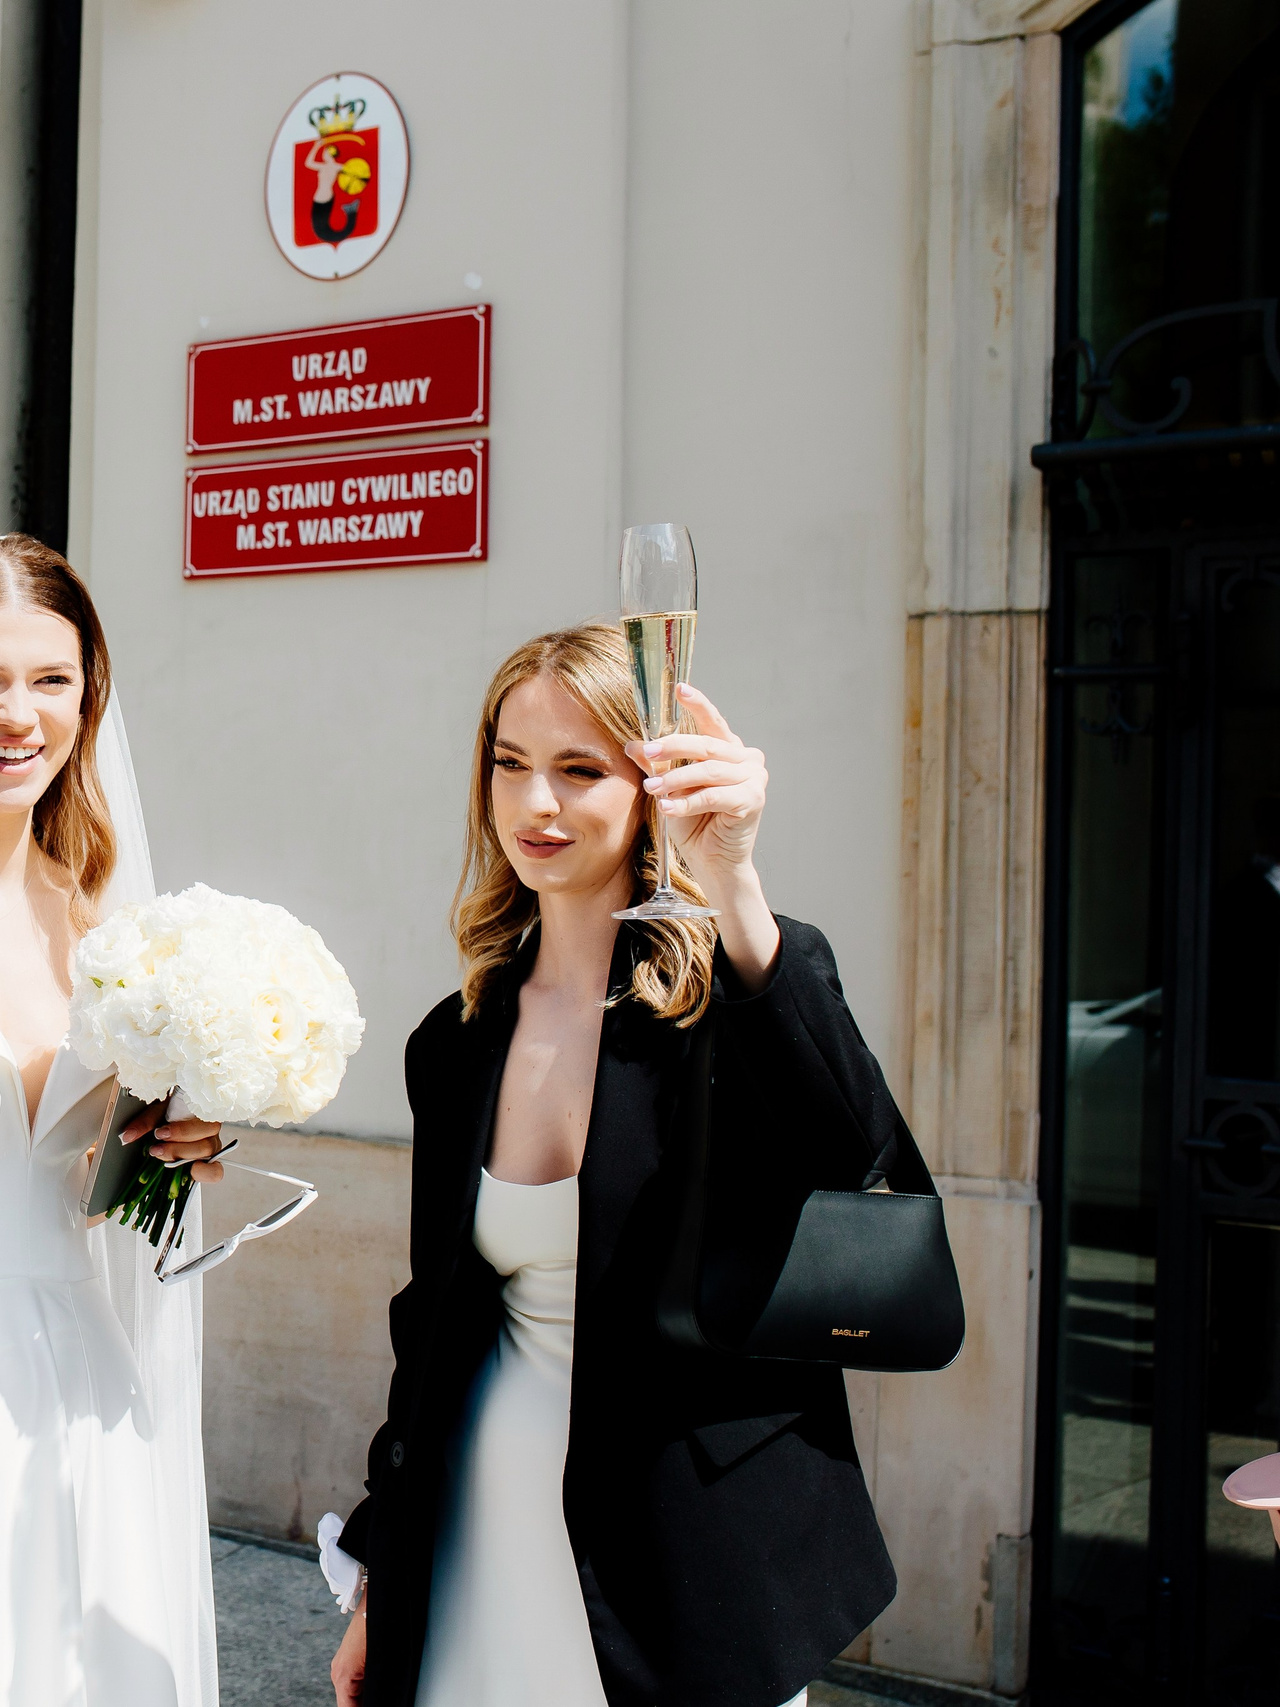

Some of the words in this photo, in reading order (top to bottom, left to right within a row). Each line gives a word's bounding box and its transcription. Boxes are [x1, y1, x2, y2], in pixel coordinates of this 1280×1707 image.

[292, 348, 368, 381] URZĄD
[232, 395, 292, 425] M.ST.
[298, 377, 432, 418] WARSZAWY
[193, 488, 261, 519] URZĄD
[266, 480, 336, 512] STANU
[341, 467, 474, 506] CYWILNEGO
[236, 522, 292, 551] M.ST.
[298, 510, 424, 546] WARSZAWY
[831, 1328, 871, 1338] BAGLLET
